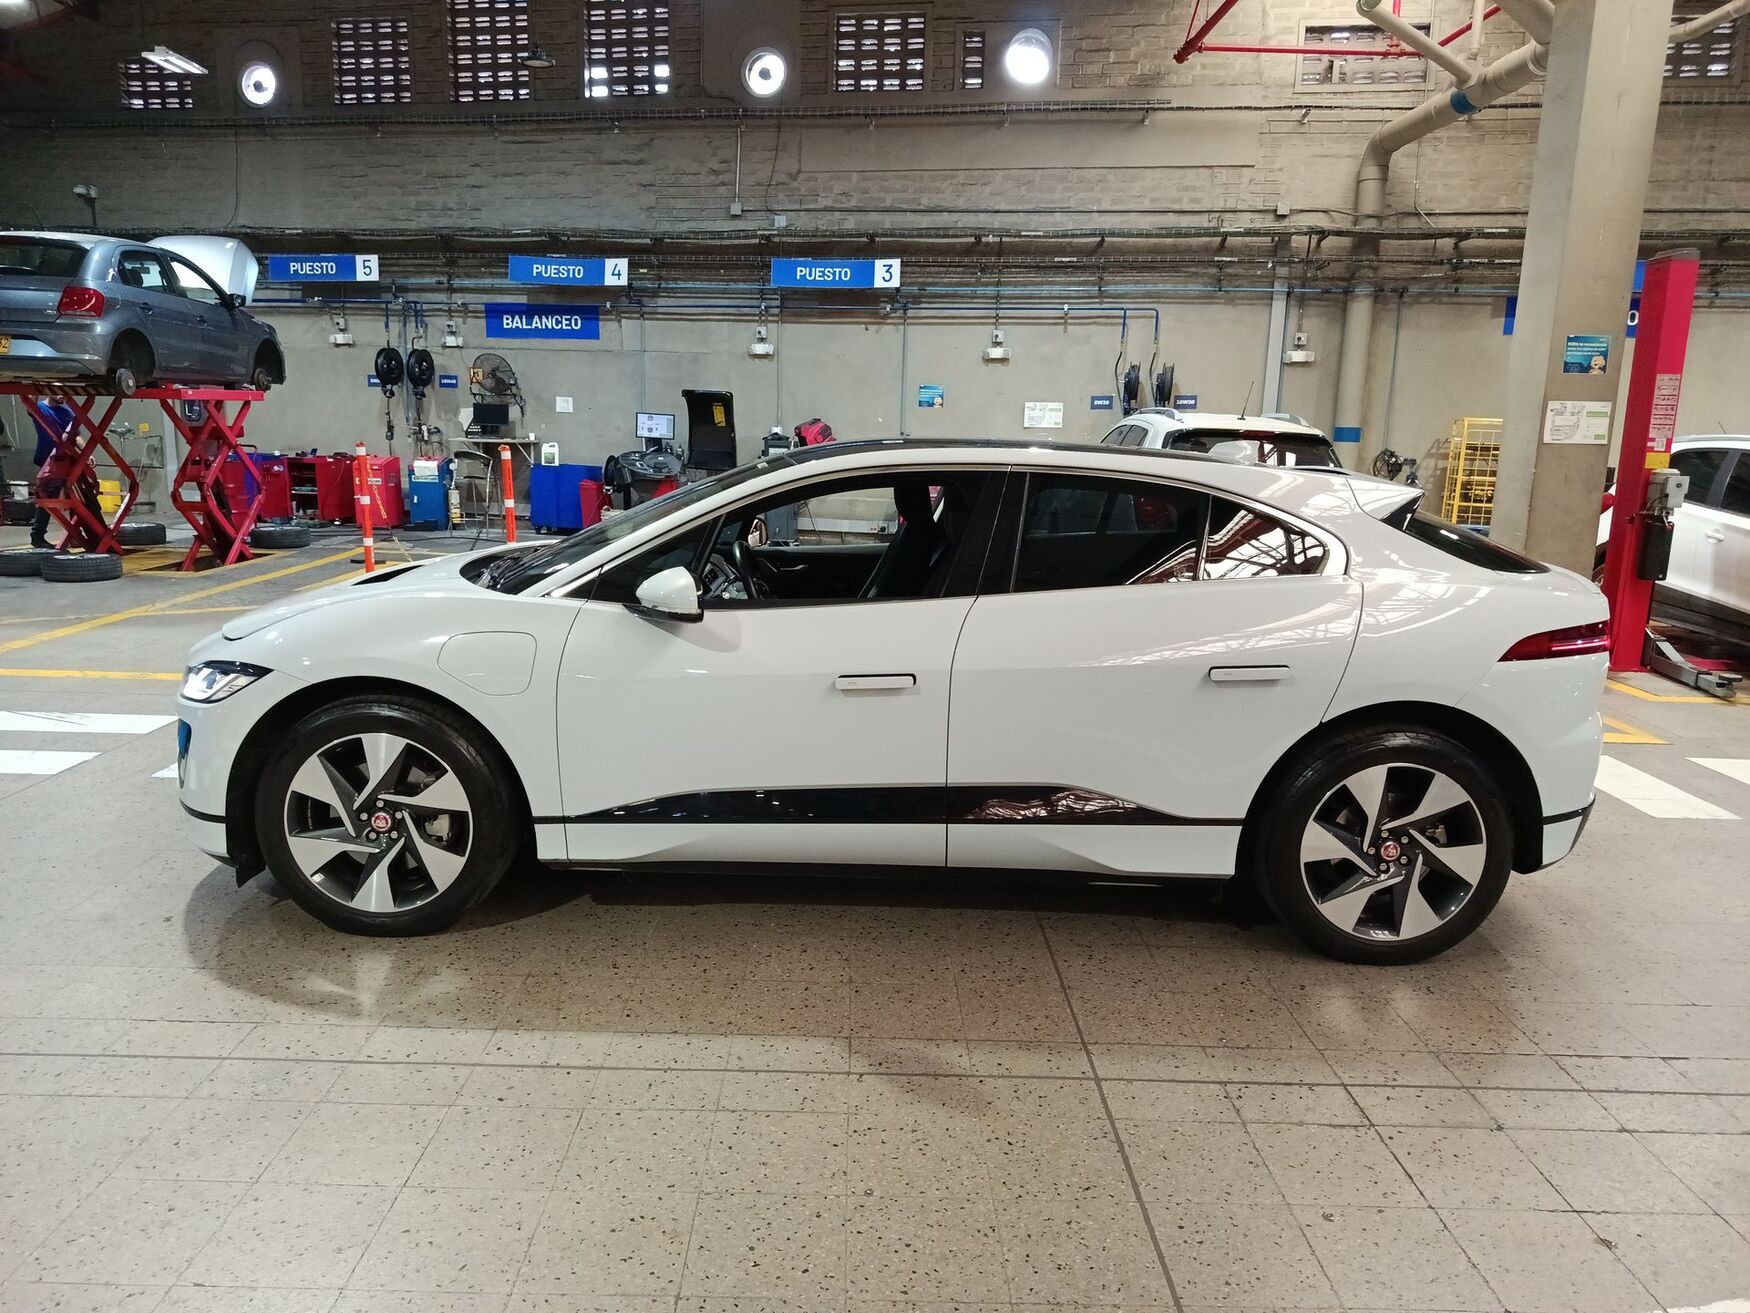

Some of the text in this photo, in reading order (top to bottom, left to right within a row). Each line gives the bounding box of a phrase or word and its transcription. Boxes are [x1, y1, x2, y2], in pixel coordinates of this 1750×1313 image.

[290, 259, 372, 276] PUESTO 5
[533, 263, 622, 280] PUESTO 4
[796, 264, 893, 282] PUESTO 3
[503, 315, 581, 329] BALANCEO
